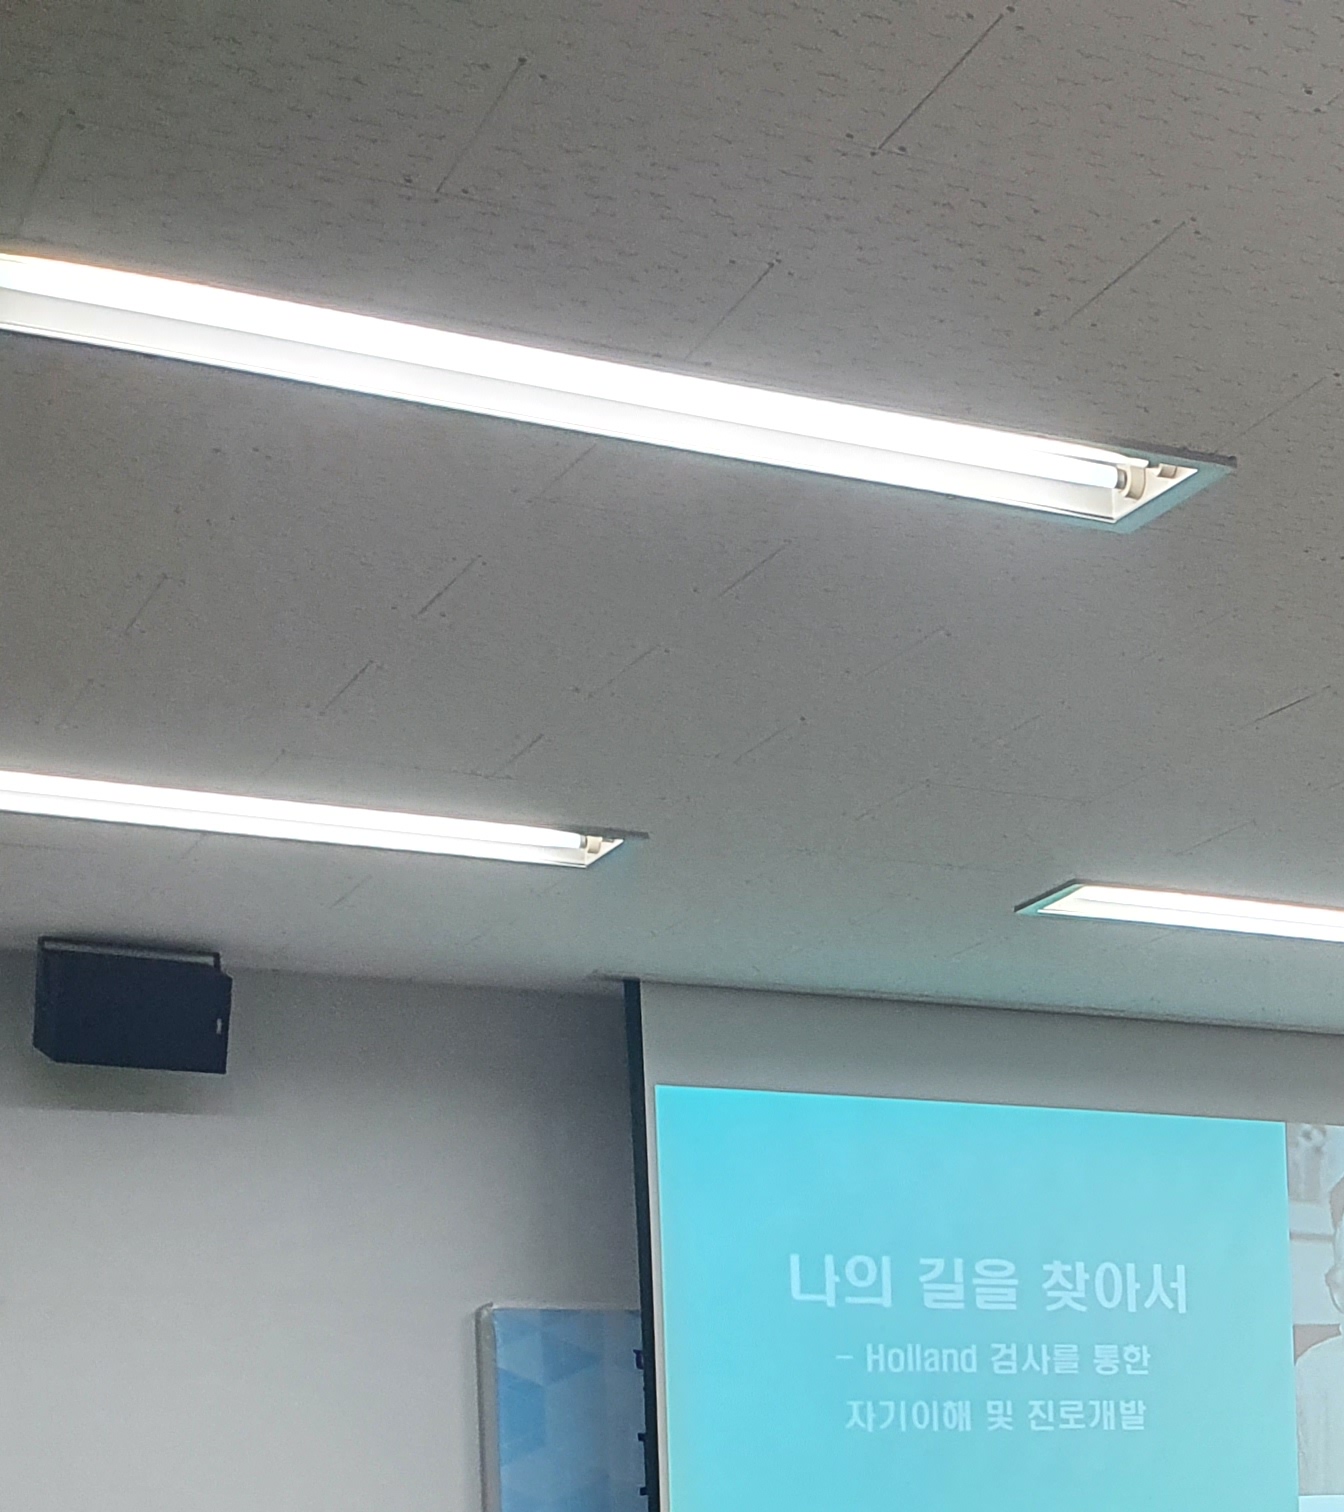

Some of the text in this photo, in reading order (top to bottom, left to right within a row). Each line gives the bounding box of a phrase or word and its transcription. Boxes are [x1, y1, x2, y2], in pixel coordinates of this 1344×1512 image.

[788, 1252, 1189, 1315] 나의 길을 찾아서
[866, 1343, 977, 1374] Holland
[990, 1343, 1080, 1376] 검사를
[1093, 1343, 1151, 1376] 통한
[845, 1398, 1146, 1433] 자기이해 및 진로개발
